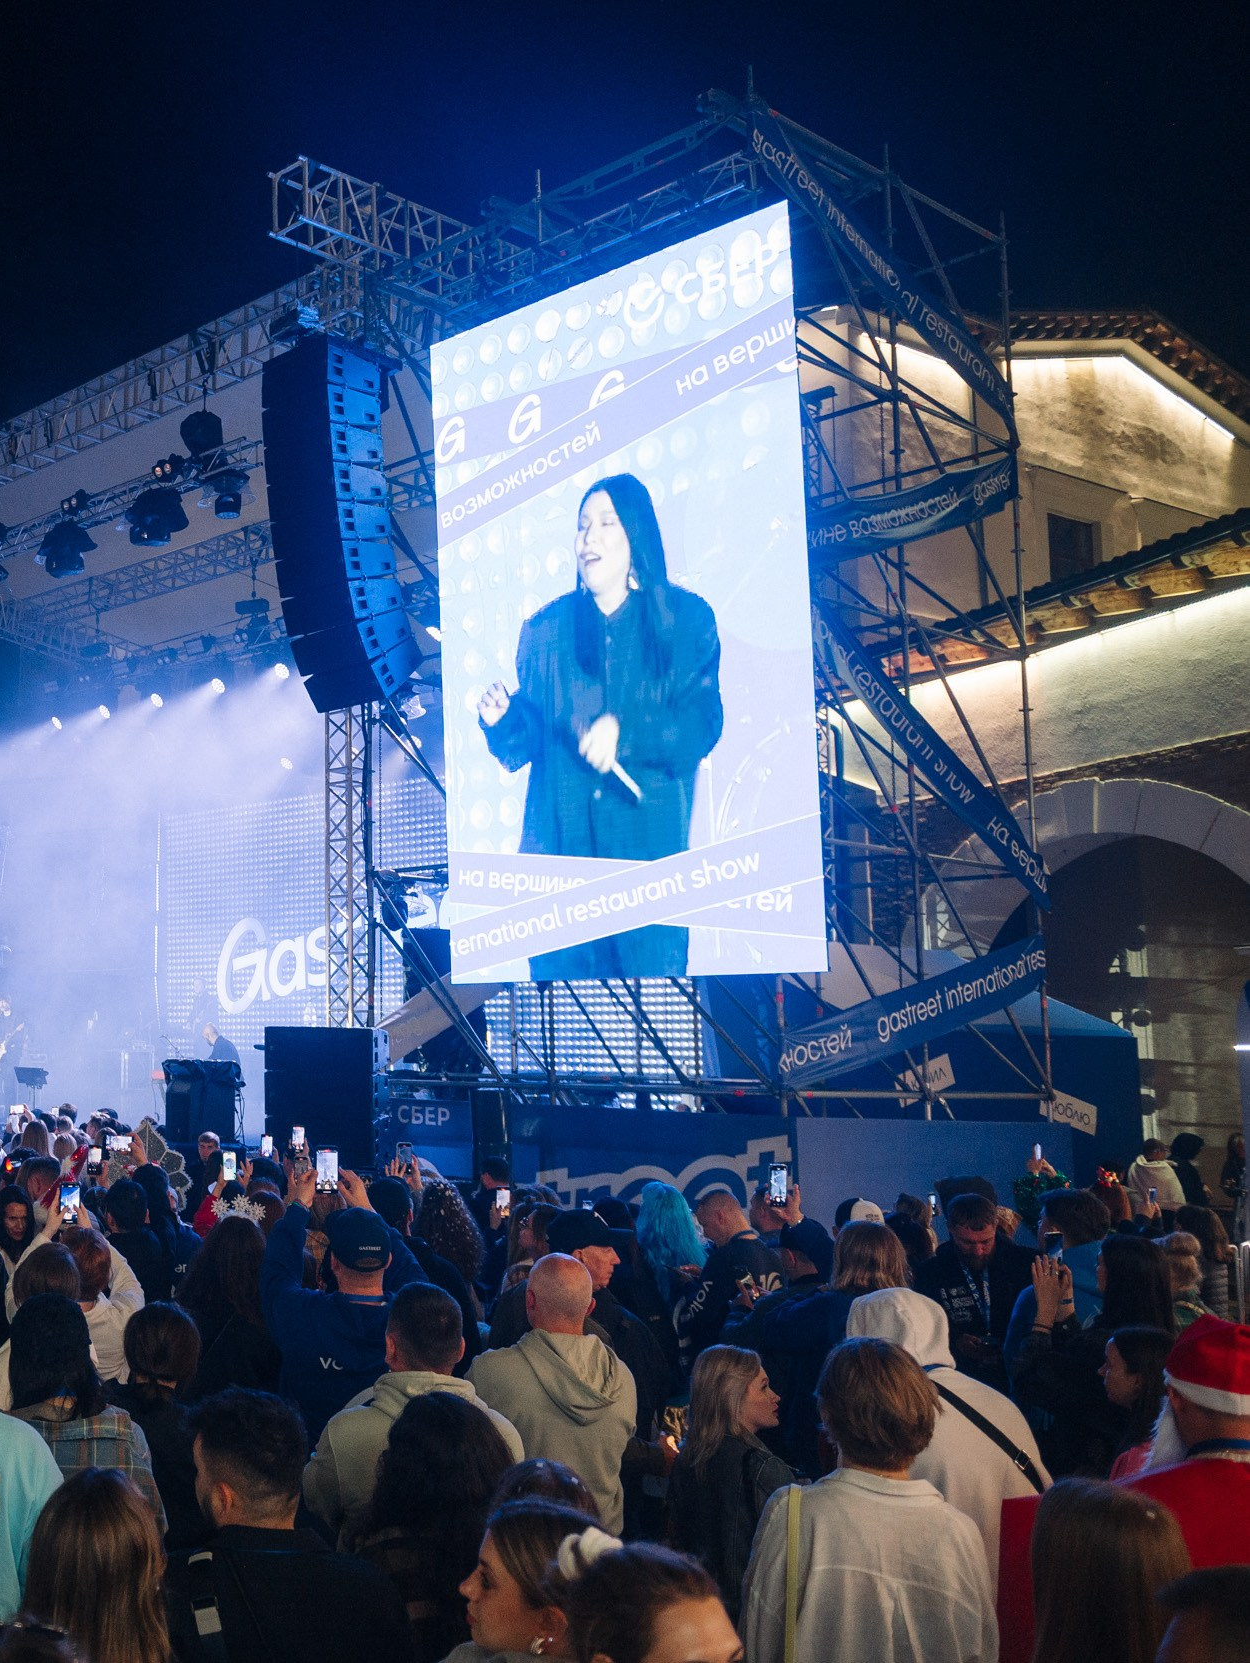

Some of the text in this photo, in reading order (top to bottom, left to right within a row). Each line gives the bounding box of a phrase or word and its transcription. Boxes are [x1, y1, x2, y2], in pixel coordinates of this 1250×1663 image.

[826, 197, 919, 315] internatioal
[675, 365, 709, 395] на
[441, 421, 601, 528] возможностей
[849, 487, 960, 538] возможностей
[458, 869, 483, 888] на
[488, 870, 587, 896] верши
[566, 872, 686, 924] restaurant
[692, 852, 759, 889] show
[877, 990, 943, 1043] gastreet
[397, 1105, 450, 1126] СБЕР
[1053, 1101, 1092, 1126] юблю
